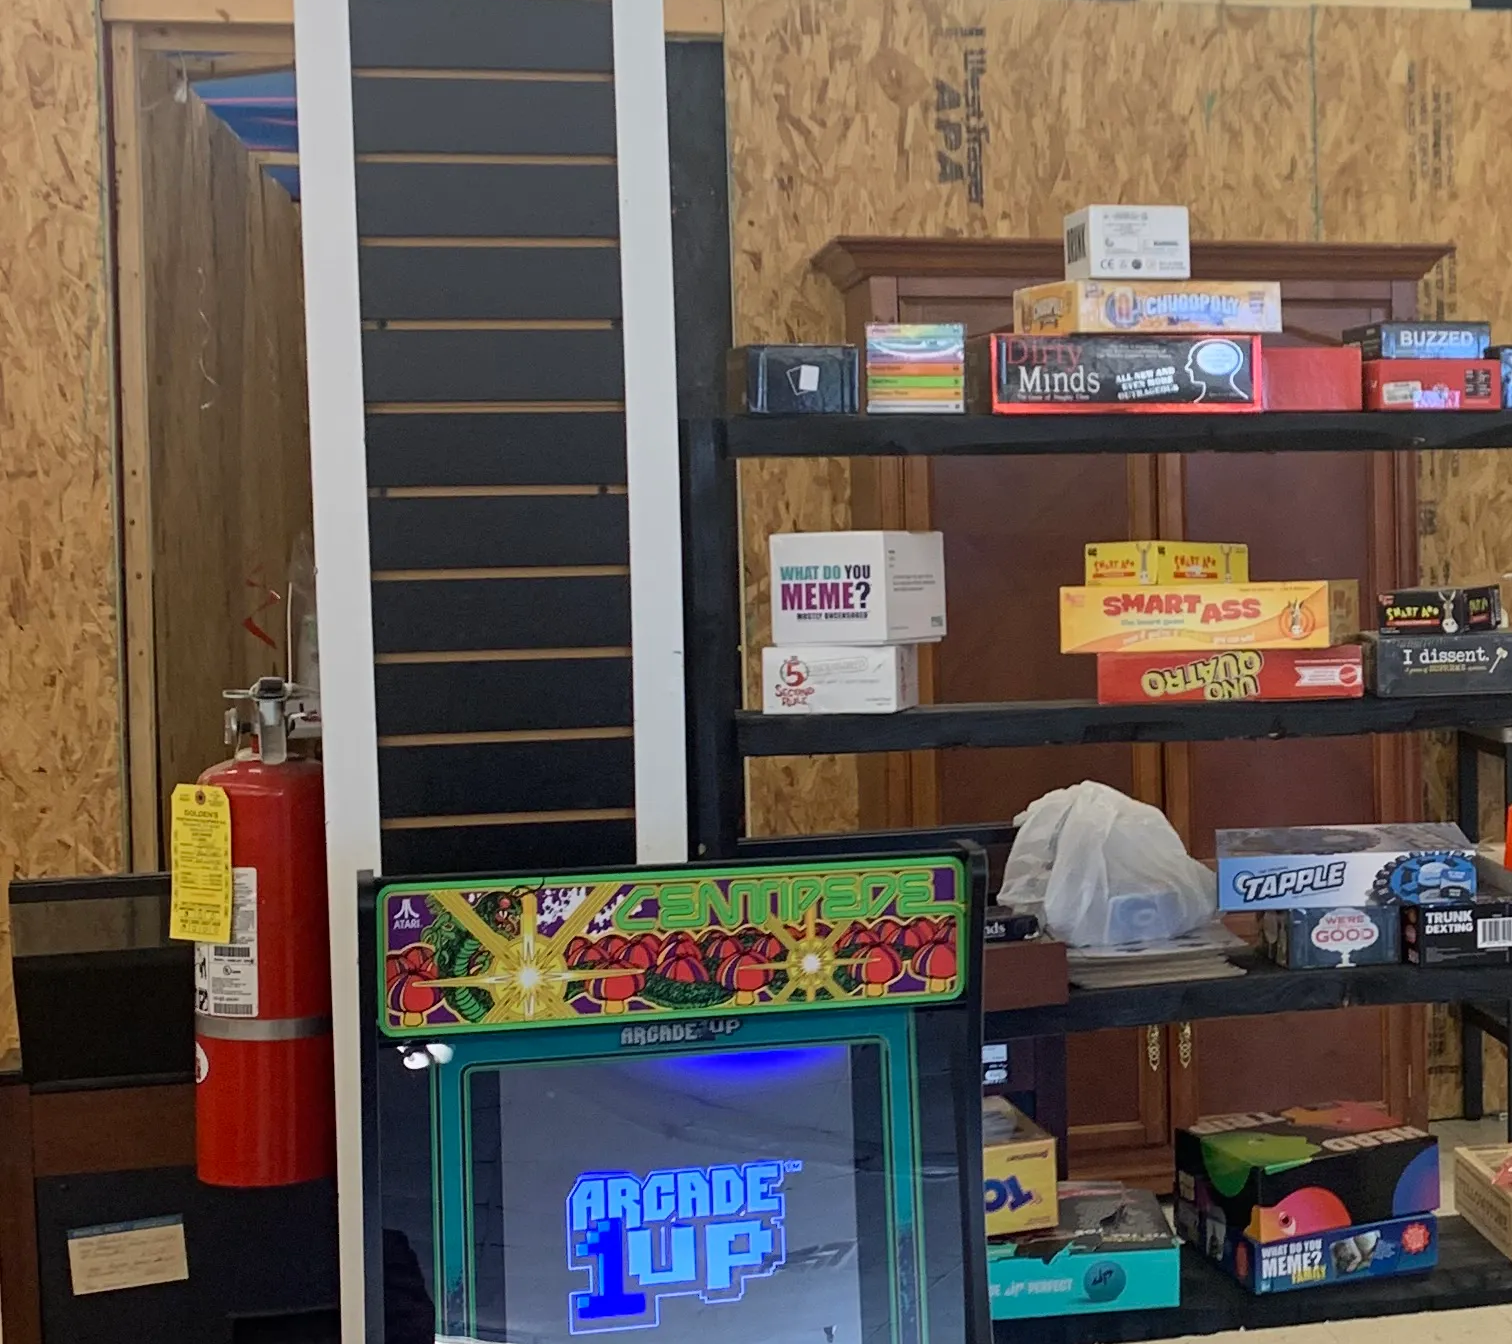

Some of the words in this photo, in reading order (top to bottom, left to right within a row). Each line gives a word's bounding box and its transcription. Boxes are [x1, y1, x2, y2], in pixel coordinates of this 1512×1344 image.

[935, 78, 963, 184] APA
[1400, 330, 1474, 348] BUZZED
[1006, 335, 1084, 373] Dirty
[1018, 365, 1101, 394] Minds
[780, 565, 819, 581] WHAT
[823, 565, 841, 580] DO
[844, 564, 871, 579] YOU
[781, 581, 871, 611] MEME?
[1103, 593, 1202, 618] SMART
[1200, 597, 1262, 625] ASS
[1402, 649, 1413, 665] I
[1419, 646, 1490, 664] dissent.
[787, 662, 808, 687] 5
[1142, 649, 1264, 698] QUATRO
[1204, 673, 1261, 702] UNO
[1243, 860, 1347, 903] TAPPLE
[615, 871, 934, 931] CENTIPEDE
[392, 917, 423, 930] ATARI
[1425, 909, 1473, 924] TRUNK
[1425, 922, 1474, 936] DEXTING
[1315, 927, 1376, 943] GOOD
[620, 1021, 698, 1046] ARCADE
[572, 1163, 781, 1232] ARCADE
[1262, 1242, 1288, 1259] WHAT
[1288, 1241, 1302, 1256] DO
[1303, 1238, 1323, 1251] YOU
[575, 1217, 773, 1319] 1UP
[1262, 1250, 1323, 1280] MEME?
